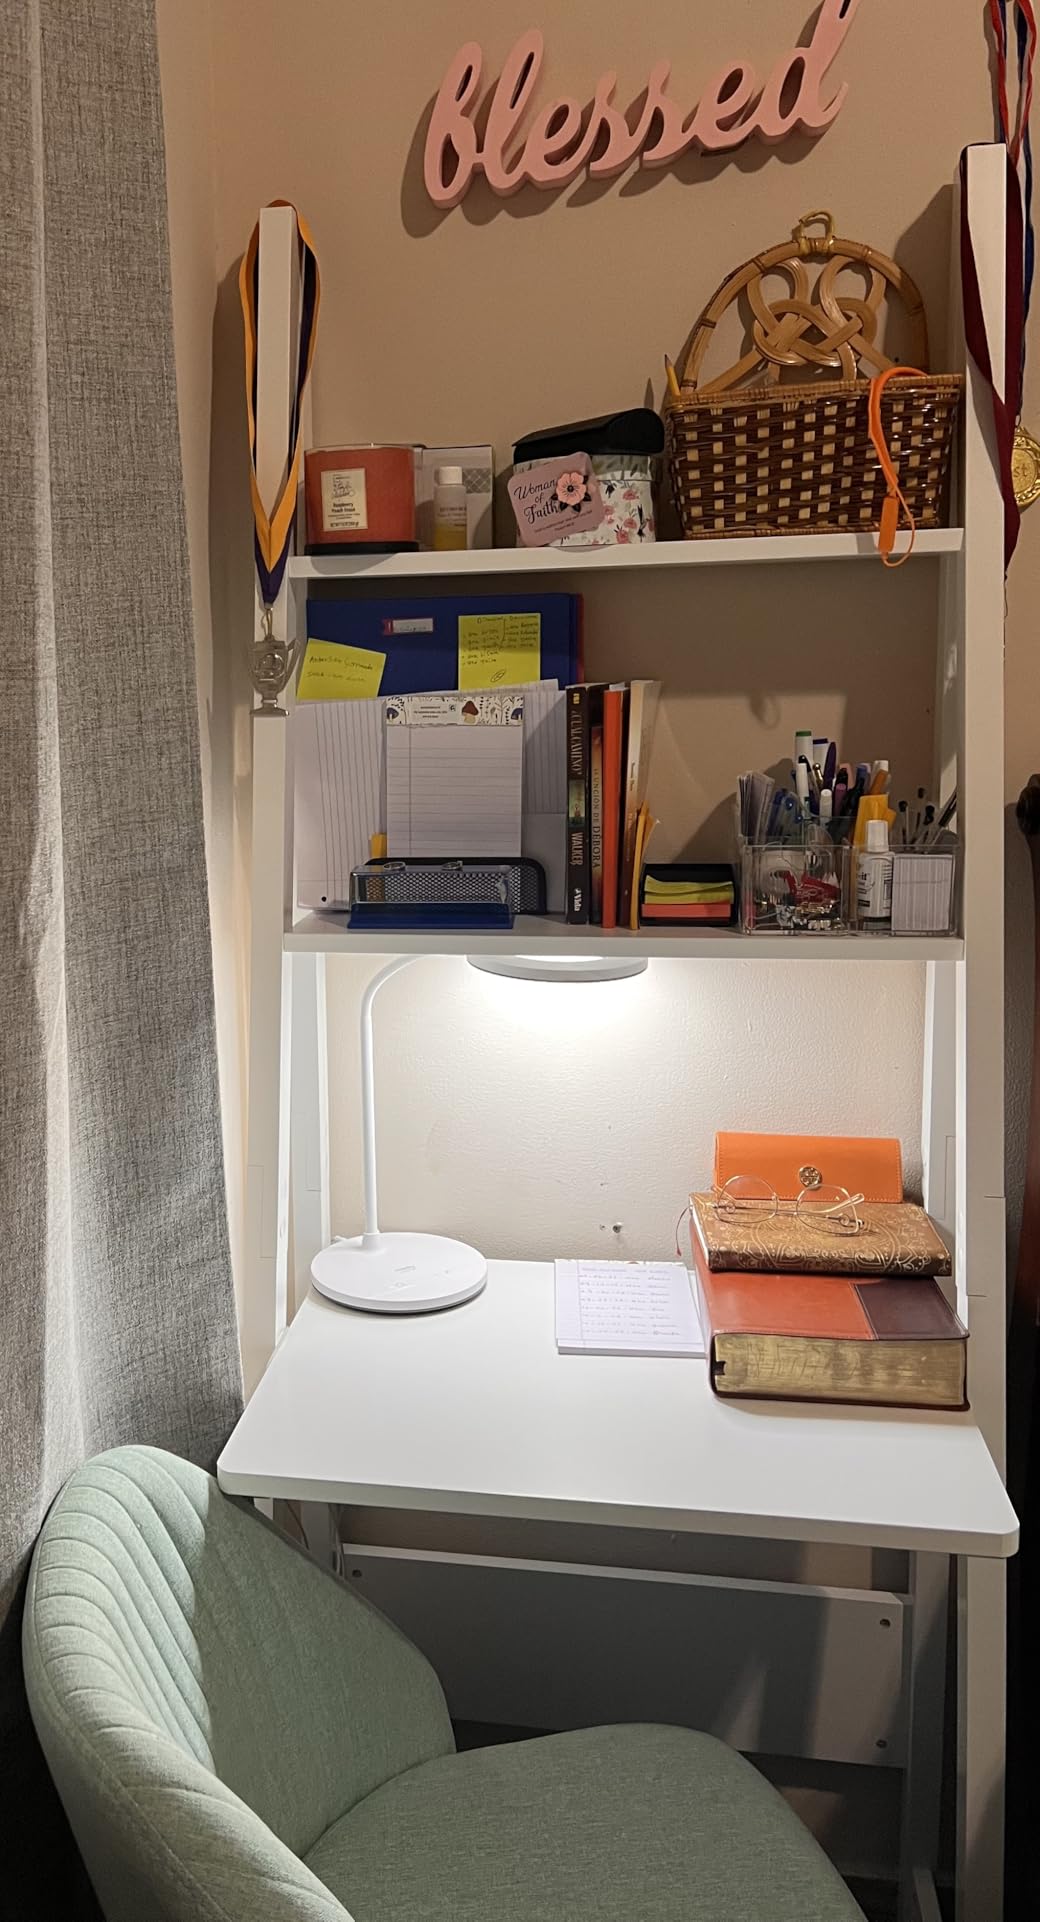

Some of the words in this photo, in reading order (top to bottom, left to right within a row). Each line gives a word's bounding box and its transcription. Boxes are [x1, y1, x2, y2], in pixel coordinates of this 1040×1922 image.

[424, 0, 858, 208] blessed
[513, 479, 557, 500] Woman
[534, 492, 545, 504] of
[523, 499, 560, 525] Faith
[569, 832, 583, 866] WALKER
